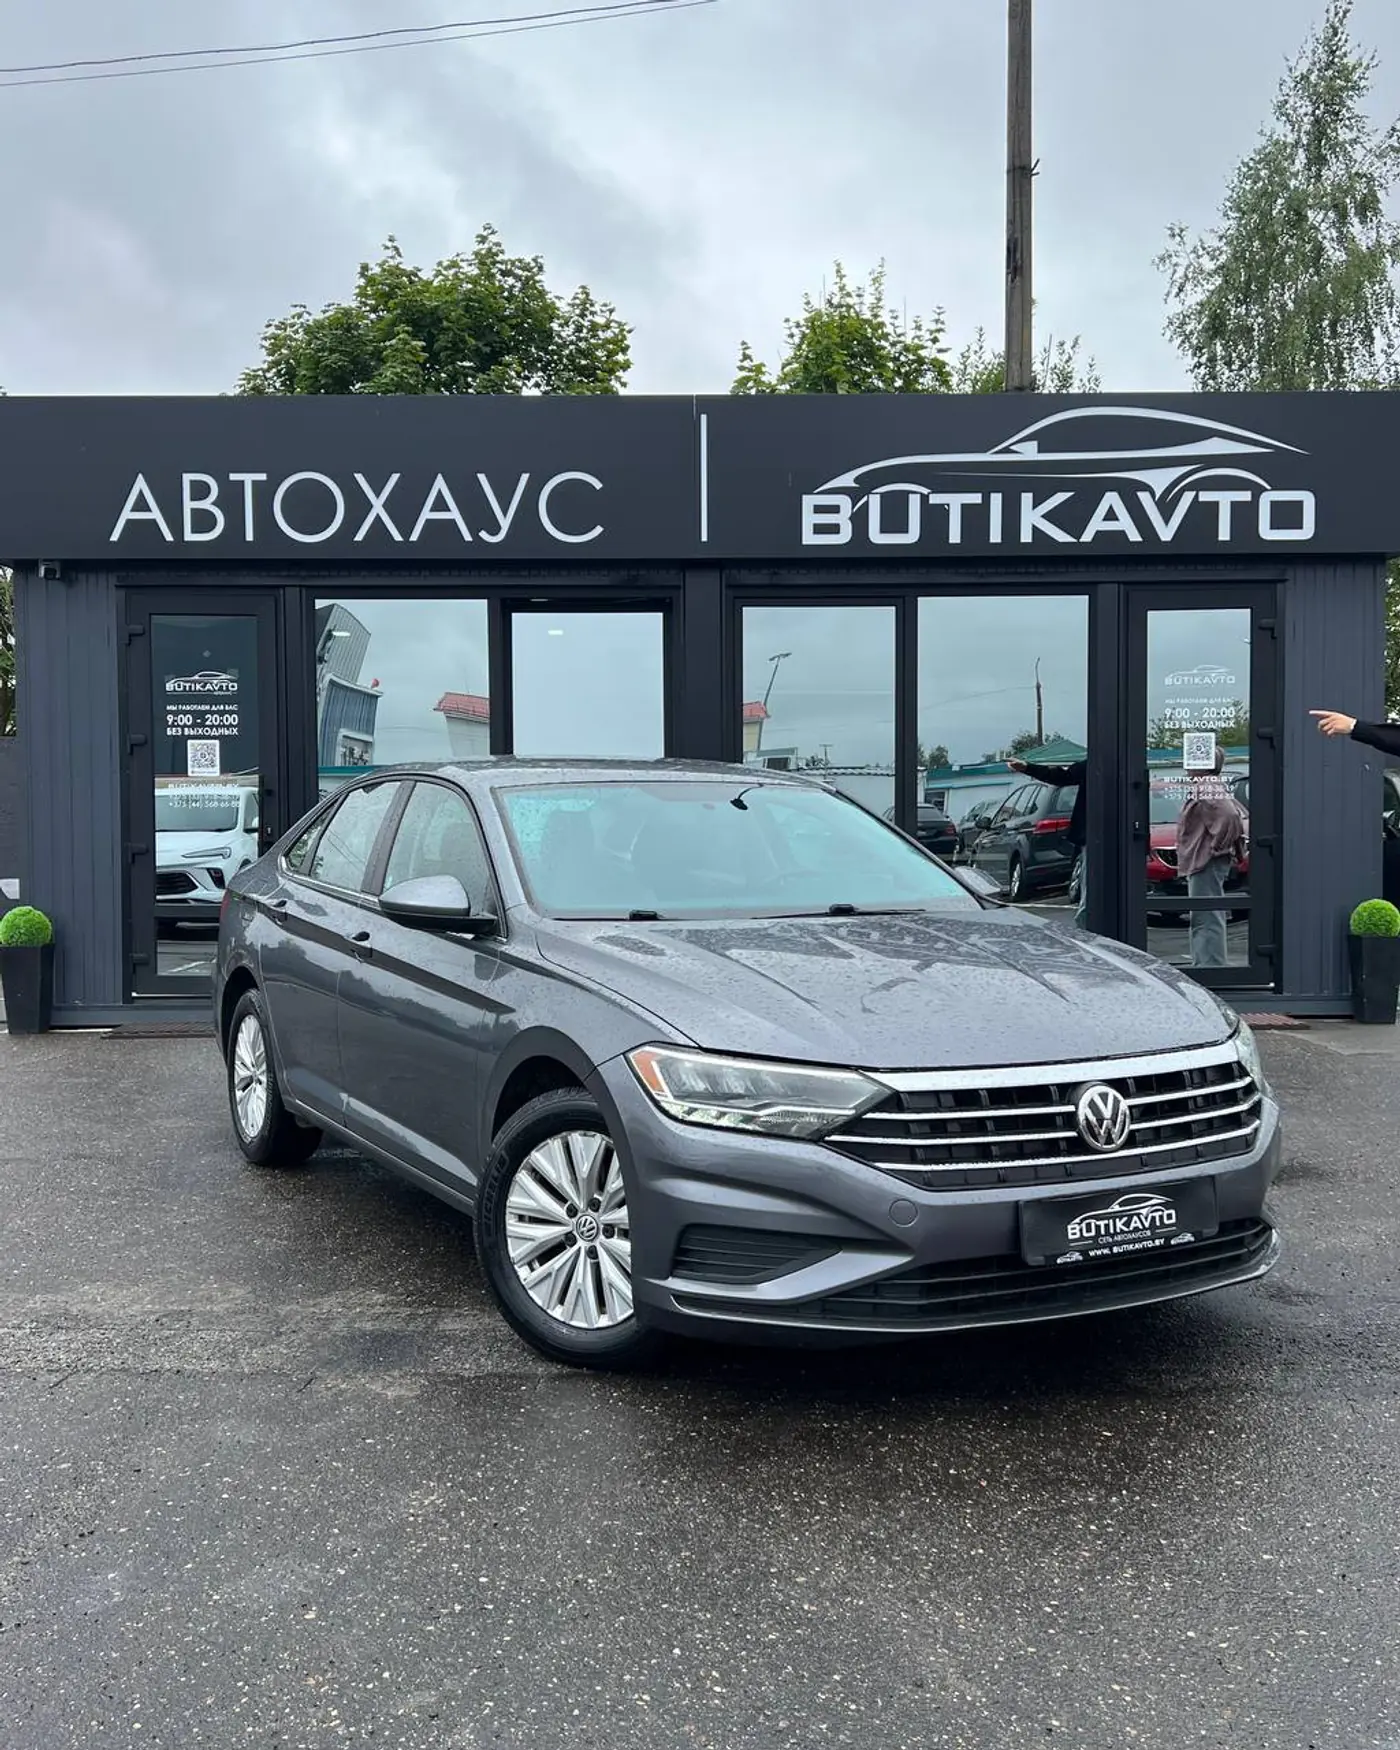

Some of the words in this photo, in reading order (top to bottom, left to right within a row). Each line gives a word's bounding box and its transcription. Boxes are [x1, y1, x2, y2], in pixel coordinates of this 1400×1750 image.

[109, 471, 605, 545] АВТОХАУС
[802, 489, 1316, 546] BUTIKAVTO
[1164, 675, 1236, 685] BUTIKAVTO
[165, 682, 238, 692] BUTIKAVTO
[1164, 707, 1190, 719] 9:00
[1202, 706, 1236, 718] 20:00
[166, 713, 193, 726] 9:00
[205, 713, 238, 726] 20:00
[1181, 720, 1236, 729] ВЫХОДНЫХ
[166, 727, 182, 736] БЕЗ
[184, 727, 239, 736] ВЫХОДНЫХ
[1067, 1209, 1176, 1240] BUTIKAVTO
[1112, 1237, 1165, 1255] BUTIKAVTO.BY
